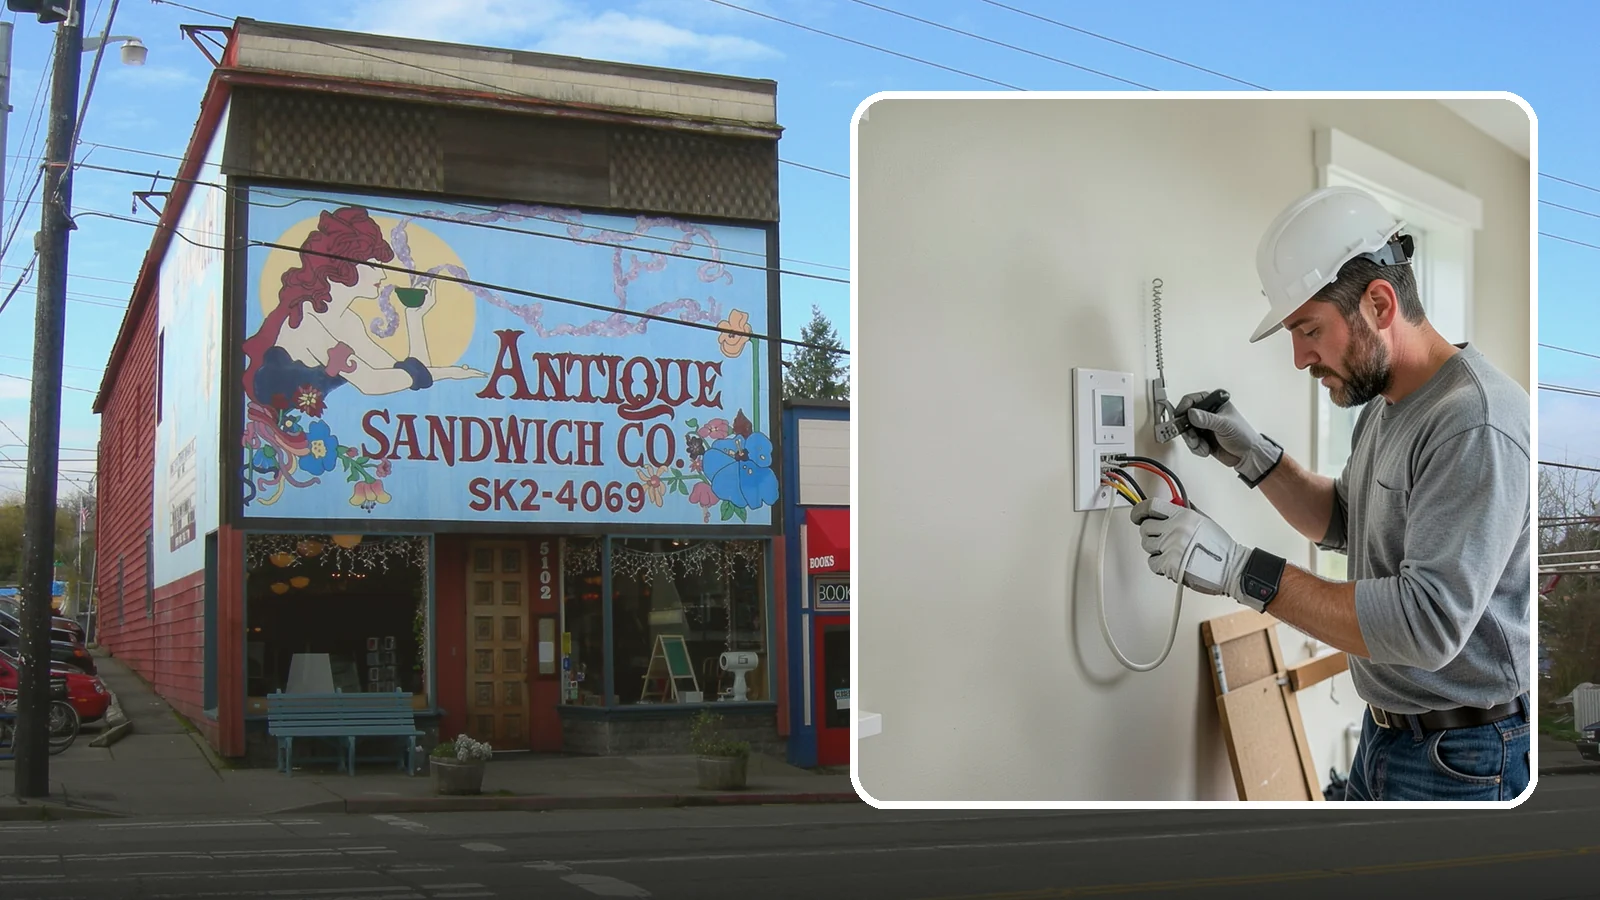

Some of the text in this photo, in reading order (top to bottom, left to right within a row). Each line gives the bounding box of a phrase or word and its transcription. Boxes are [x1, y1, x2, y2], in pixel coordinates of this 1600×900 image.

[476, 328, 723, 421] ANTIQUE
[361, 408, 685, 469] SANDWICH CO.
[468, 477, 646, 513] SK2-4069
[539, 541, 552, 600] 5102
[809, 555, 834, 568] BOOKS
